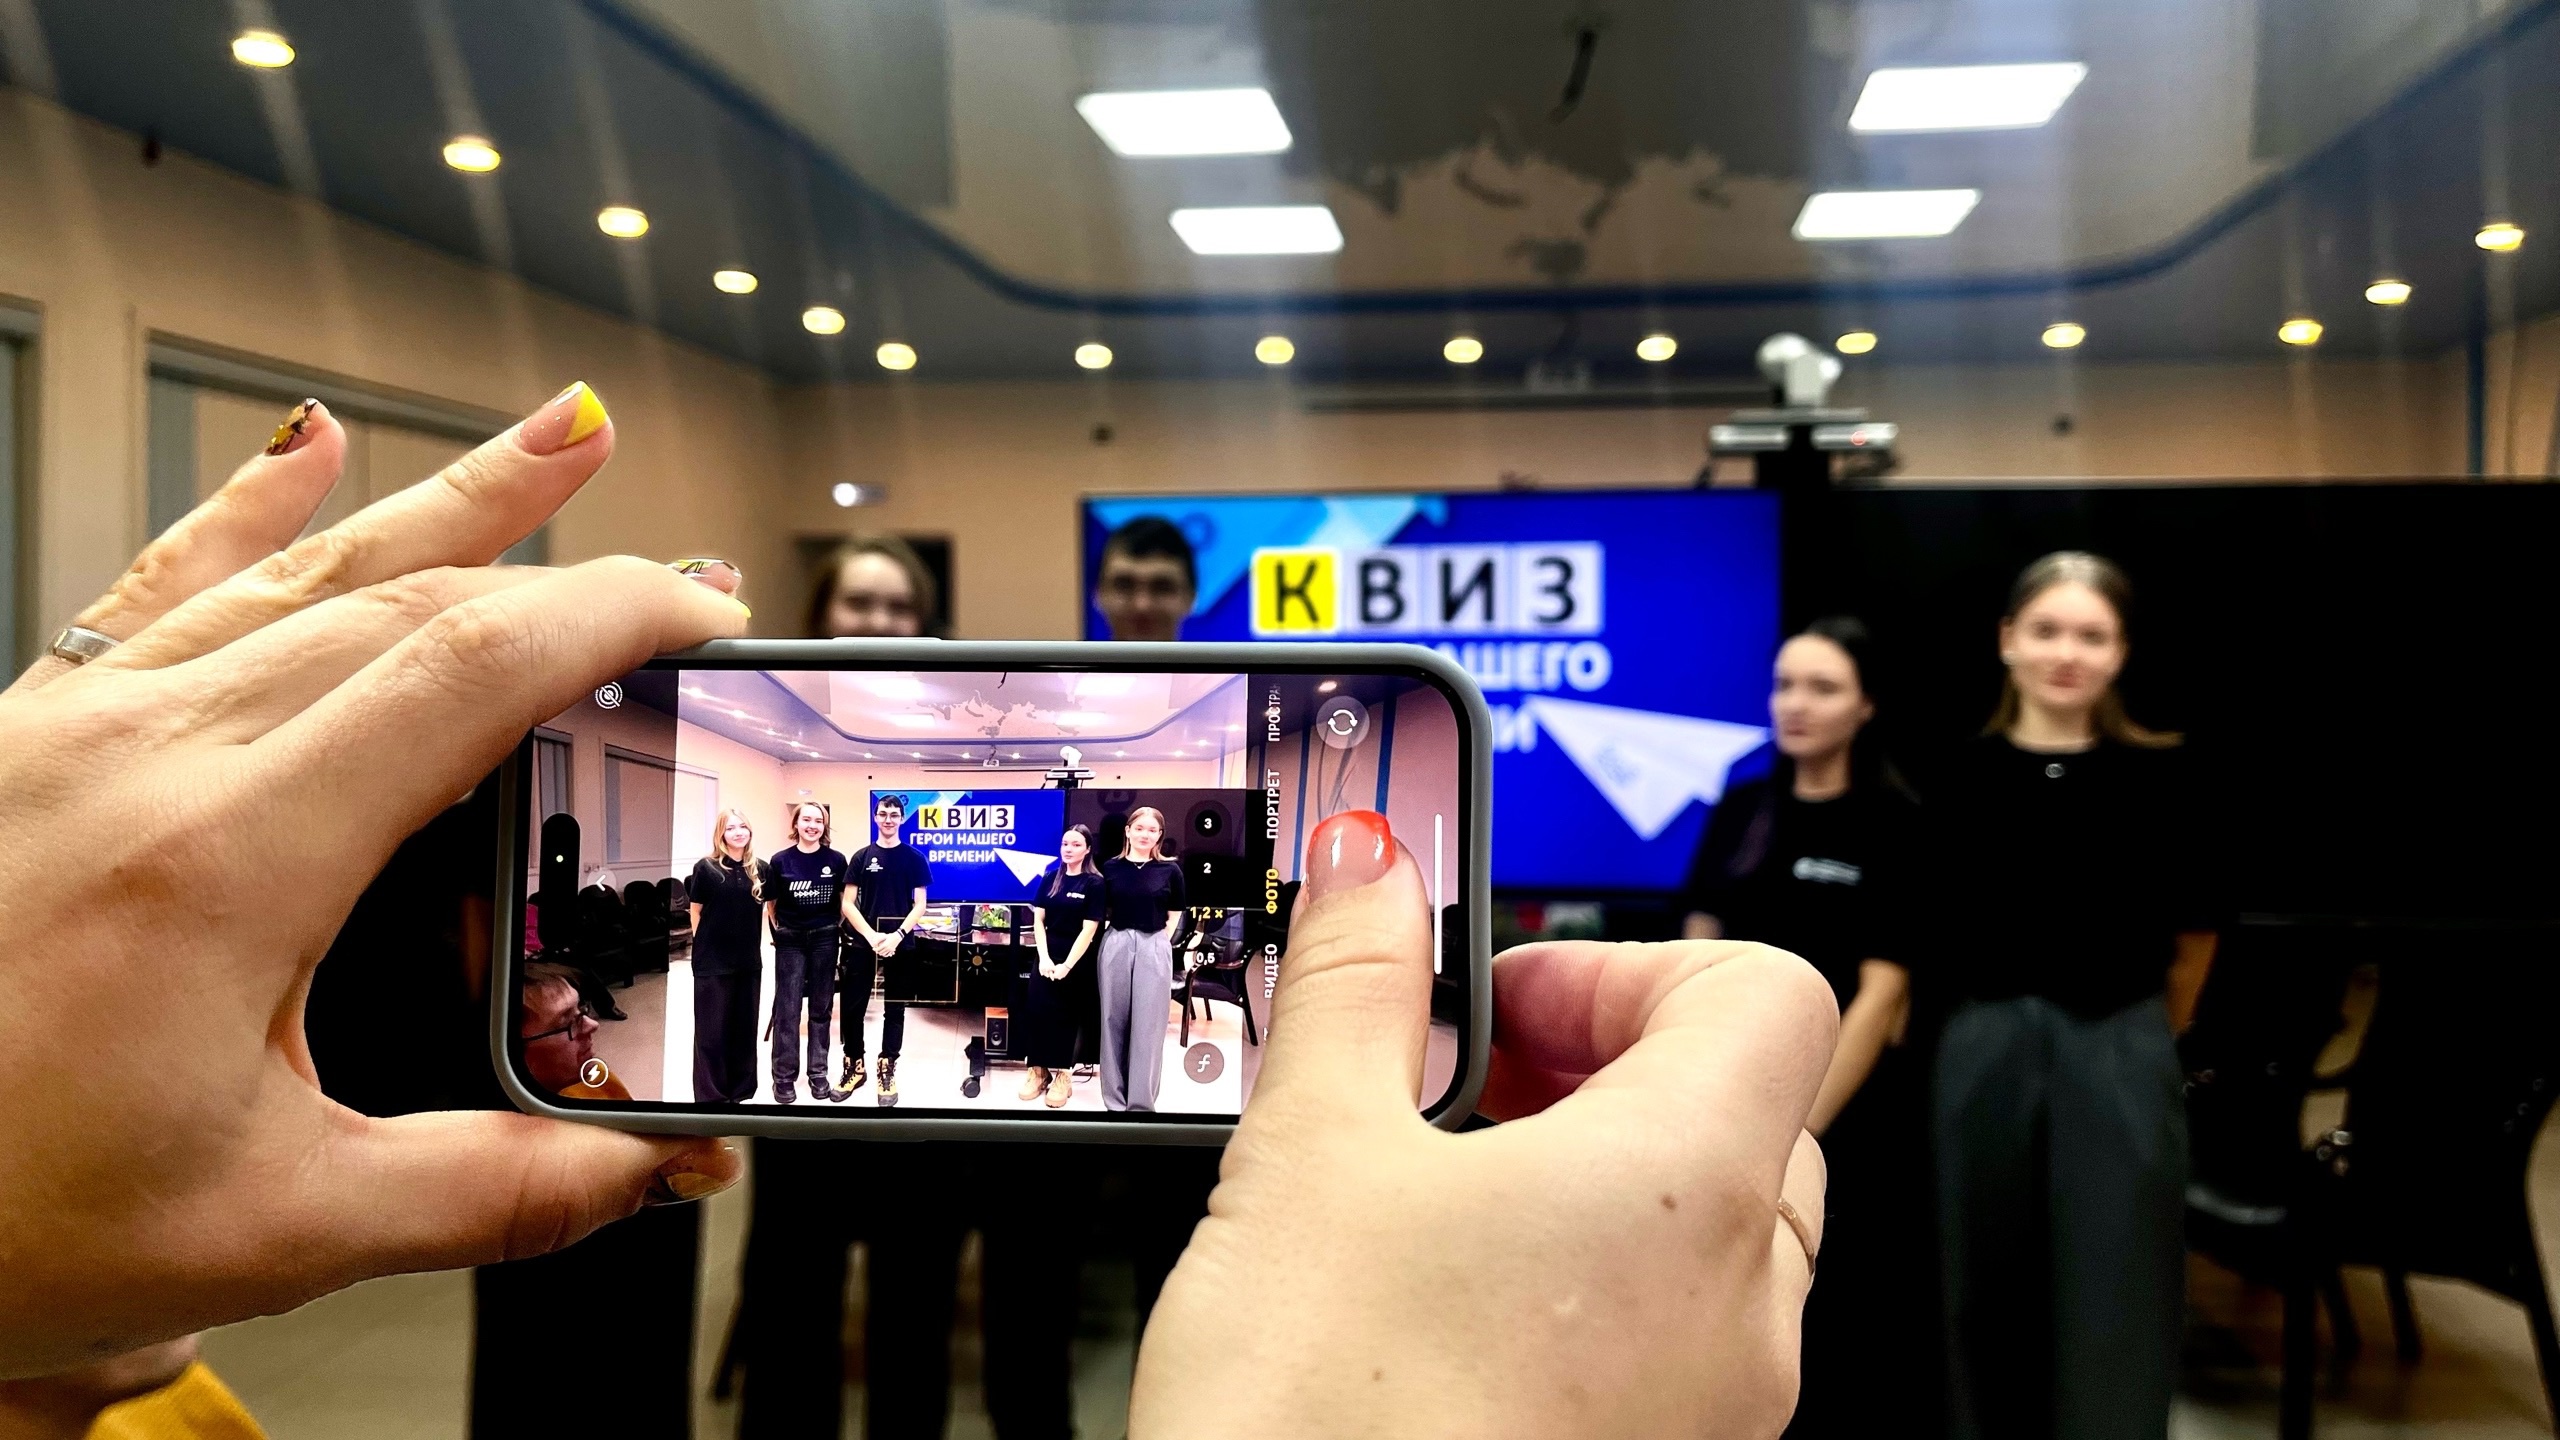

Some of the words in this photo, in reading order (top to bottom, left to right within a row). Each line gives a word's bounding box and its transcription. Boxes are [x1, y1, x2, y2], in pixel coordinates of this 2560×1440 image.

[1274, 556, 1576, 626] КВИЗ
[1430, 641, 1613, 692] ШЕГО
[1266, 768, 1280, 839] ПОРТРЕТ
[923, 807, 1009, 828] КВИЗ
[1203, 818, 1212, 829] 3
[910, 833, 953, 845] ГЕРОИ
[957, 832, 1016, 846] НАШЕГО
[928, 850, 996, 863] ВРЕМЕНИ
[1203, 862, 1212, 874] 2
[1266, 868, 1279, 914] ФОТО
[1196, 952, 1215, 965] 0,5
